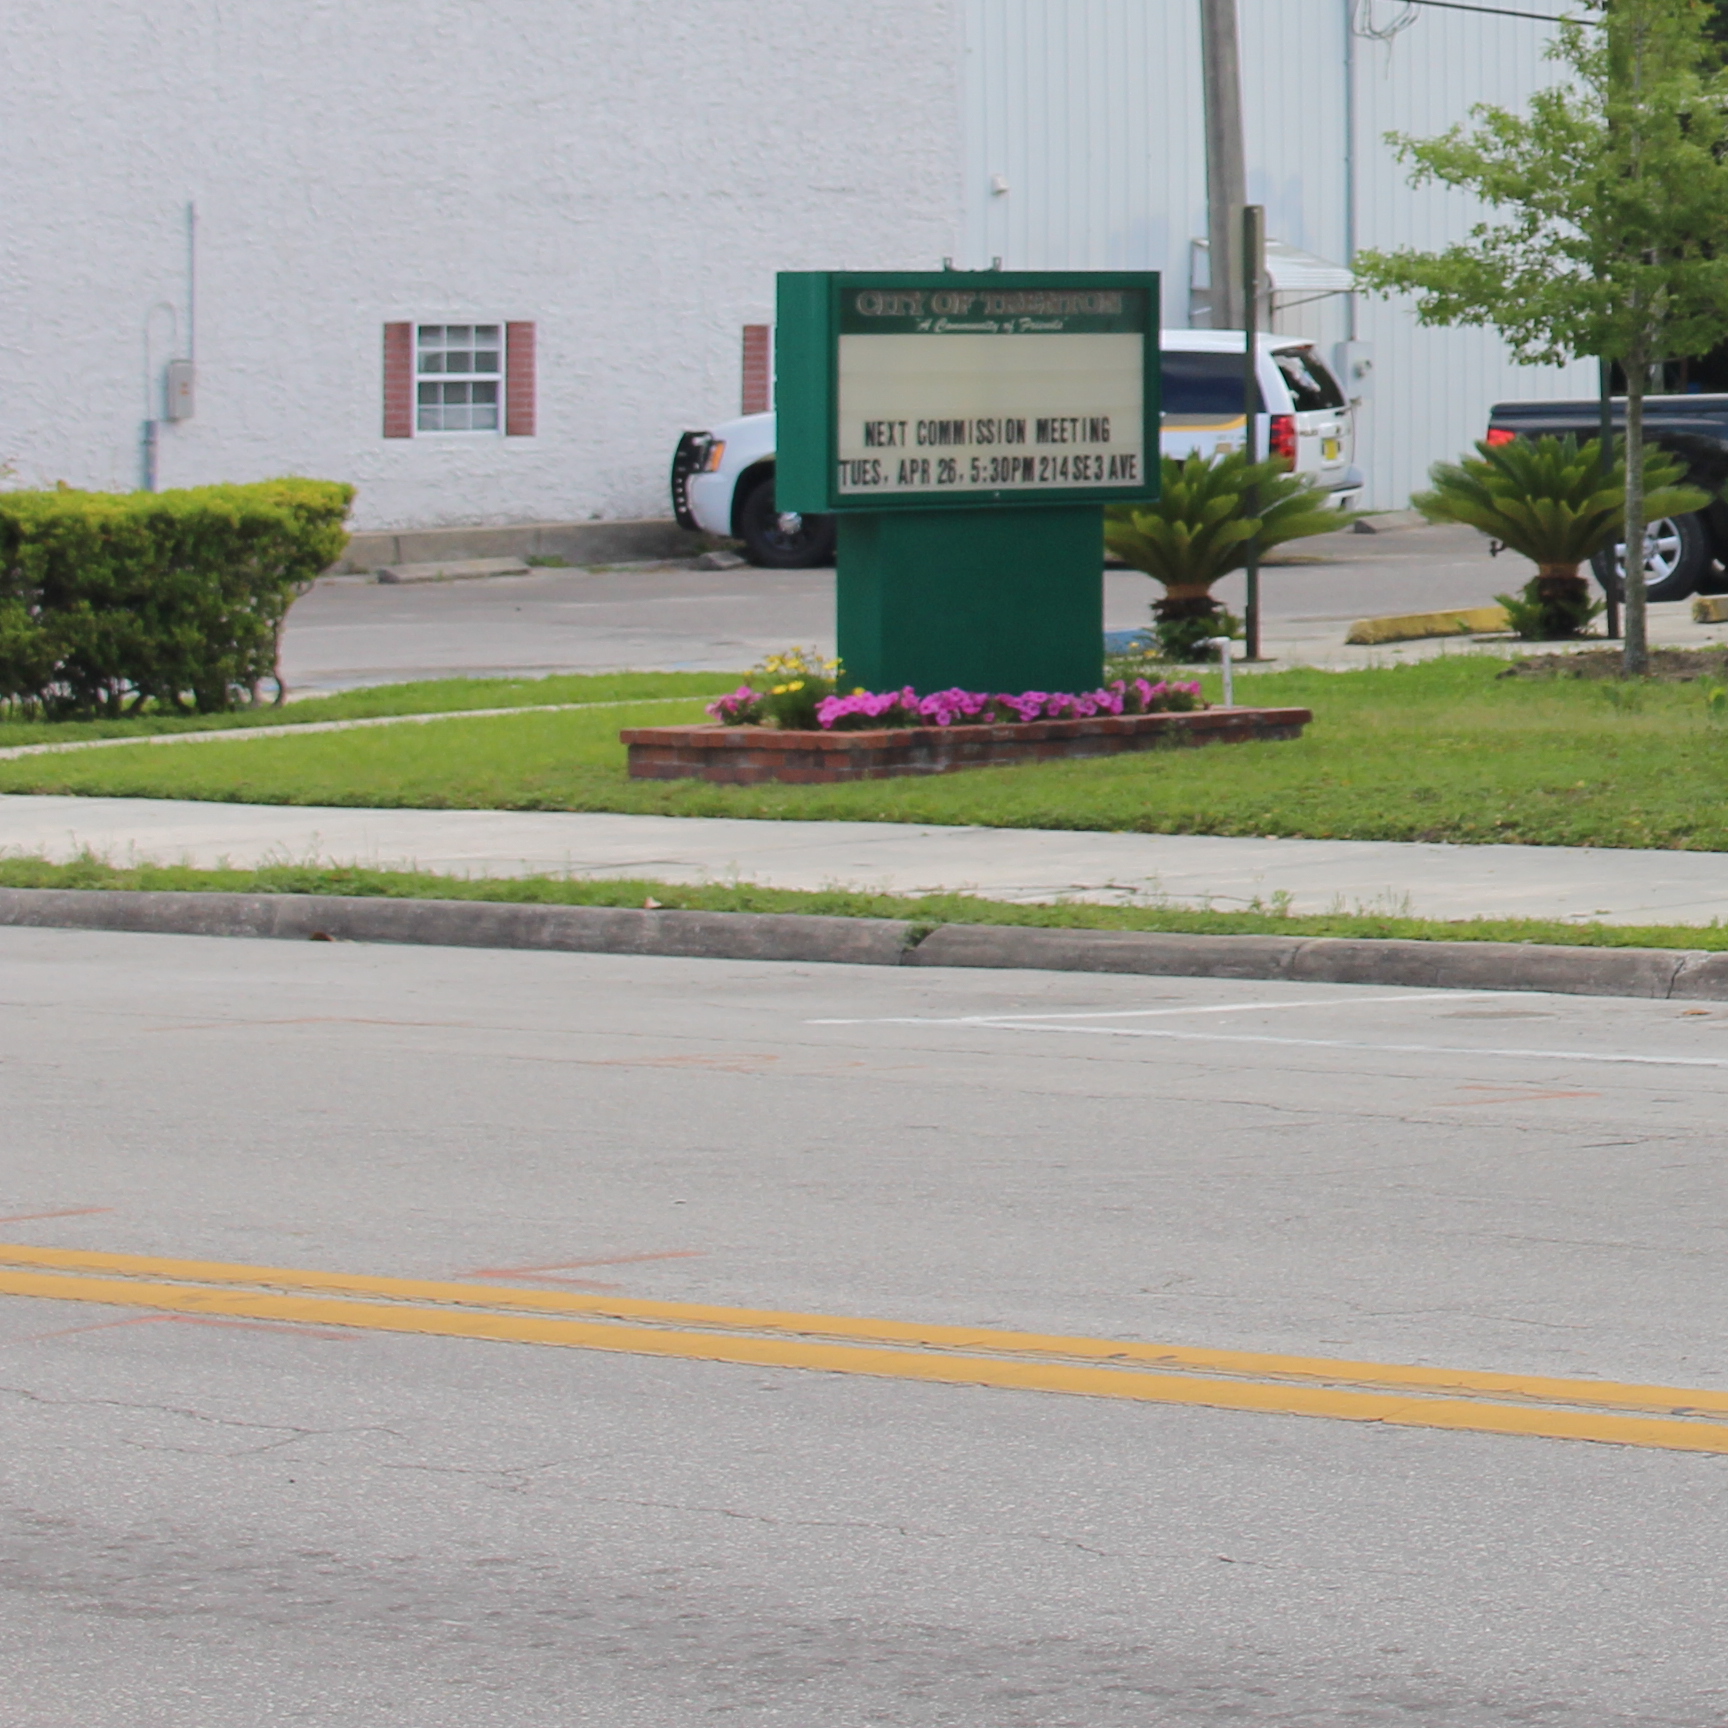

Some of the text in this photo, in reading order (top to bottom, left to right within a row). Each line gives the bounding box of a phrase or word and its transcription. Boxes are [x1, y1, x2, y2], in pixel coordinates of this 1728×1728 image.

[855, 290, 1123, 316] CITY OF TRENTON
[934, 317, 1000, 333] Community
[864, 417, 1110, 447] NEXT COMMISSION MEETING
[898, 458, 930, 484] APR
[970, 456, 1035, 483] 5:30PM
[1039, 455, 1068, 481] 214
[1073, 455, 1091, 481] SE
[1094, 455, 1104, 480] 3
[1108, 454, 1137, 480] AVE
